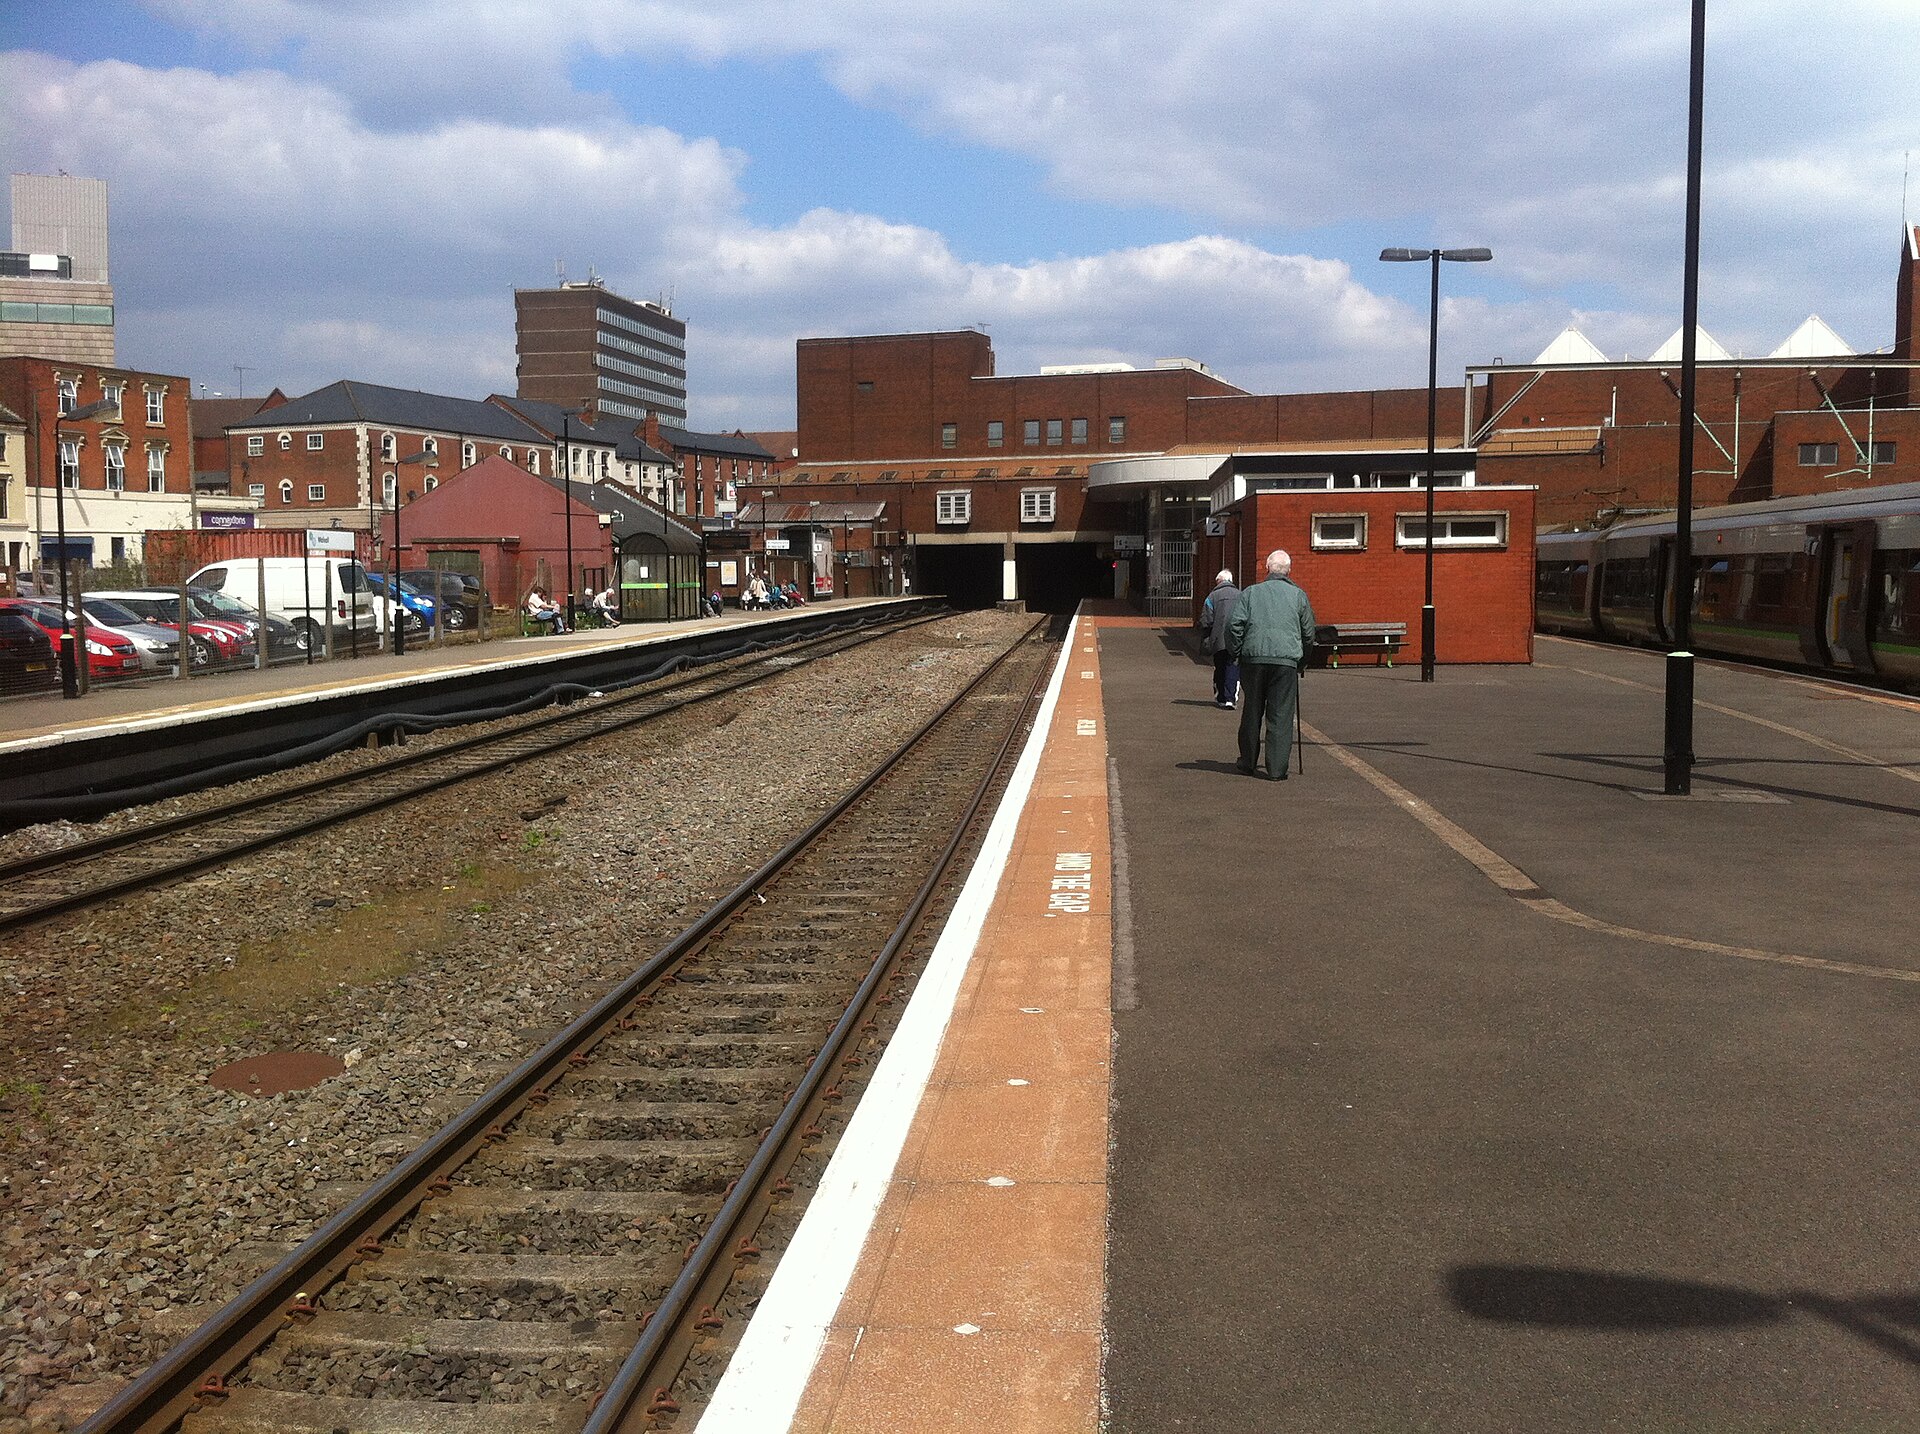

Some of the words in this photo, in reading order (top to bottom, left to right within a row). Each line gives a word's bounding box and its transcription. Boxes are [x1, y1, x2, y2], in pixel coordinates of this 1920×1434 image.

[1211, 521, 1220, 534] 2
[1054, 852, 1092, 871] MIND
[1050, 873, 1092, 890] THE
[1048, 892, 1090, 913] GAP
